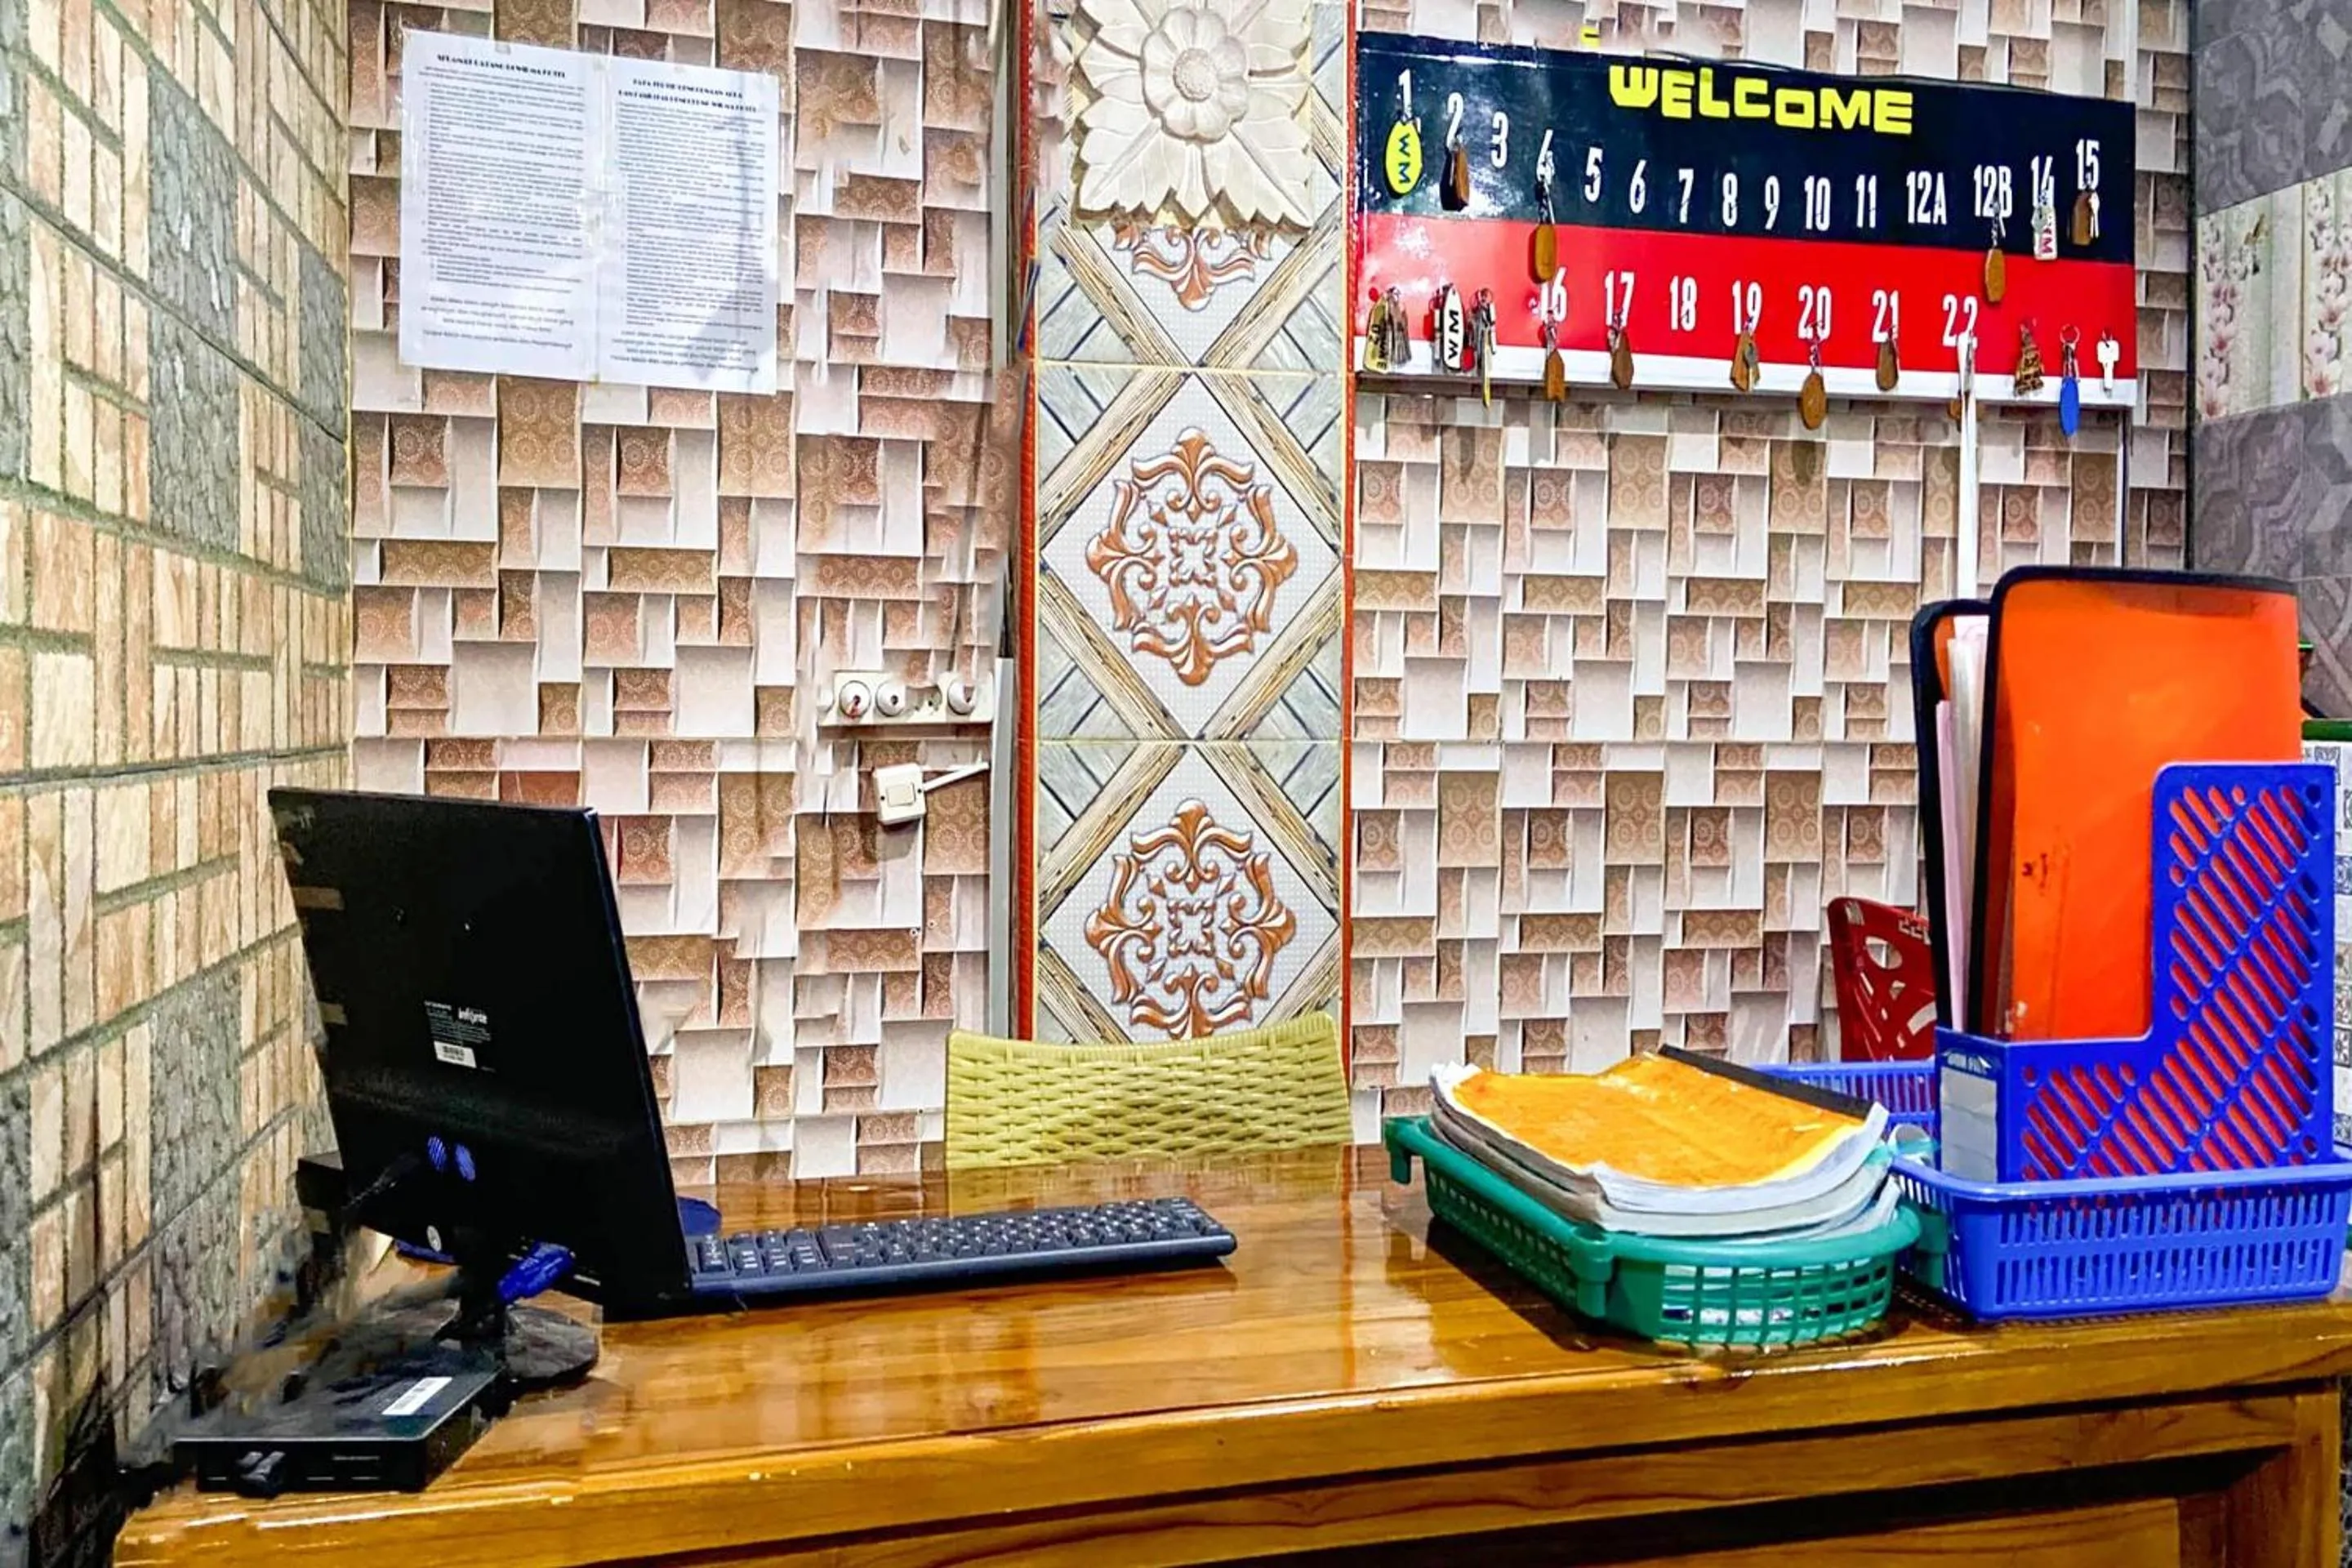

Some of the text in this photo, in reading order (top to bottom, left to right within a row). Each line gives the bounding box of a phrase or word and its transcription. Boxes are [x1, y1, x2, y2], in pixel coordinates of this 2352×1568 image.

[1609, 65, 1913, 135] WELCOME
[1398, 69, 1413, 122] 1
[1446, 92, 1463, 151] 2
[1491, 111, 1508, 167] 3
[1584, 147, 1603, 203] 5
[1629, 159, 1646, 214] 6
[1678, 168, 1694, 224] 7
[1722, 172, 1738, 227] 8
[1765, 175, 1780, 229] 9
[1804, 175, 1831, 231] 10
[1855, 174, 1877, 228] 11
[1906, 171, 1947, 225] 12A
[1973, 164, 2012, 218] 12B
[2030, 155, 2055, 207] 14
[2075, 139, 2100, 190] 15
[1539, 266, 1978, 349] 16 17 18 19 20 21 22
